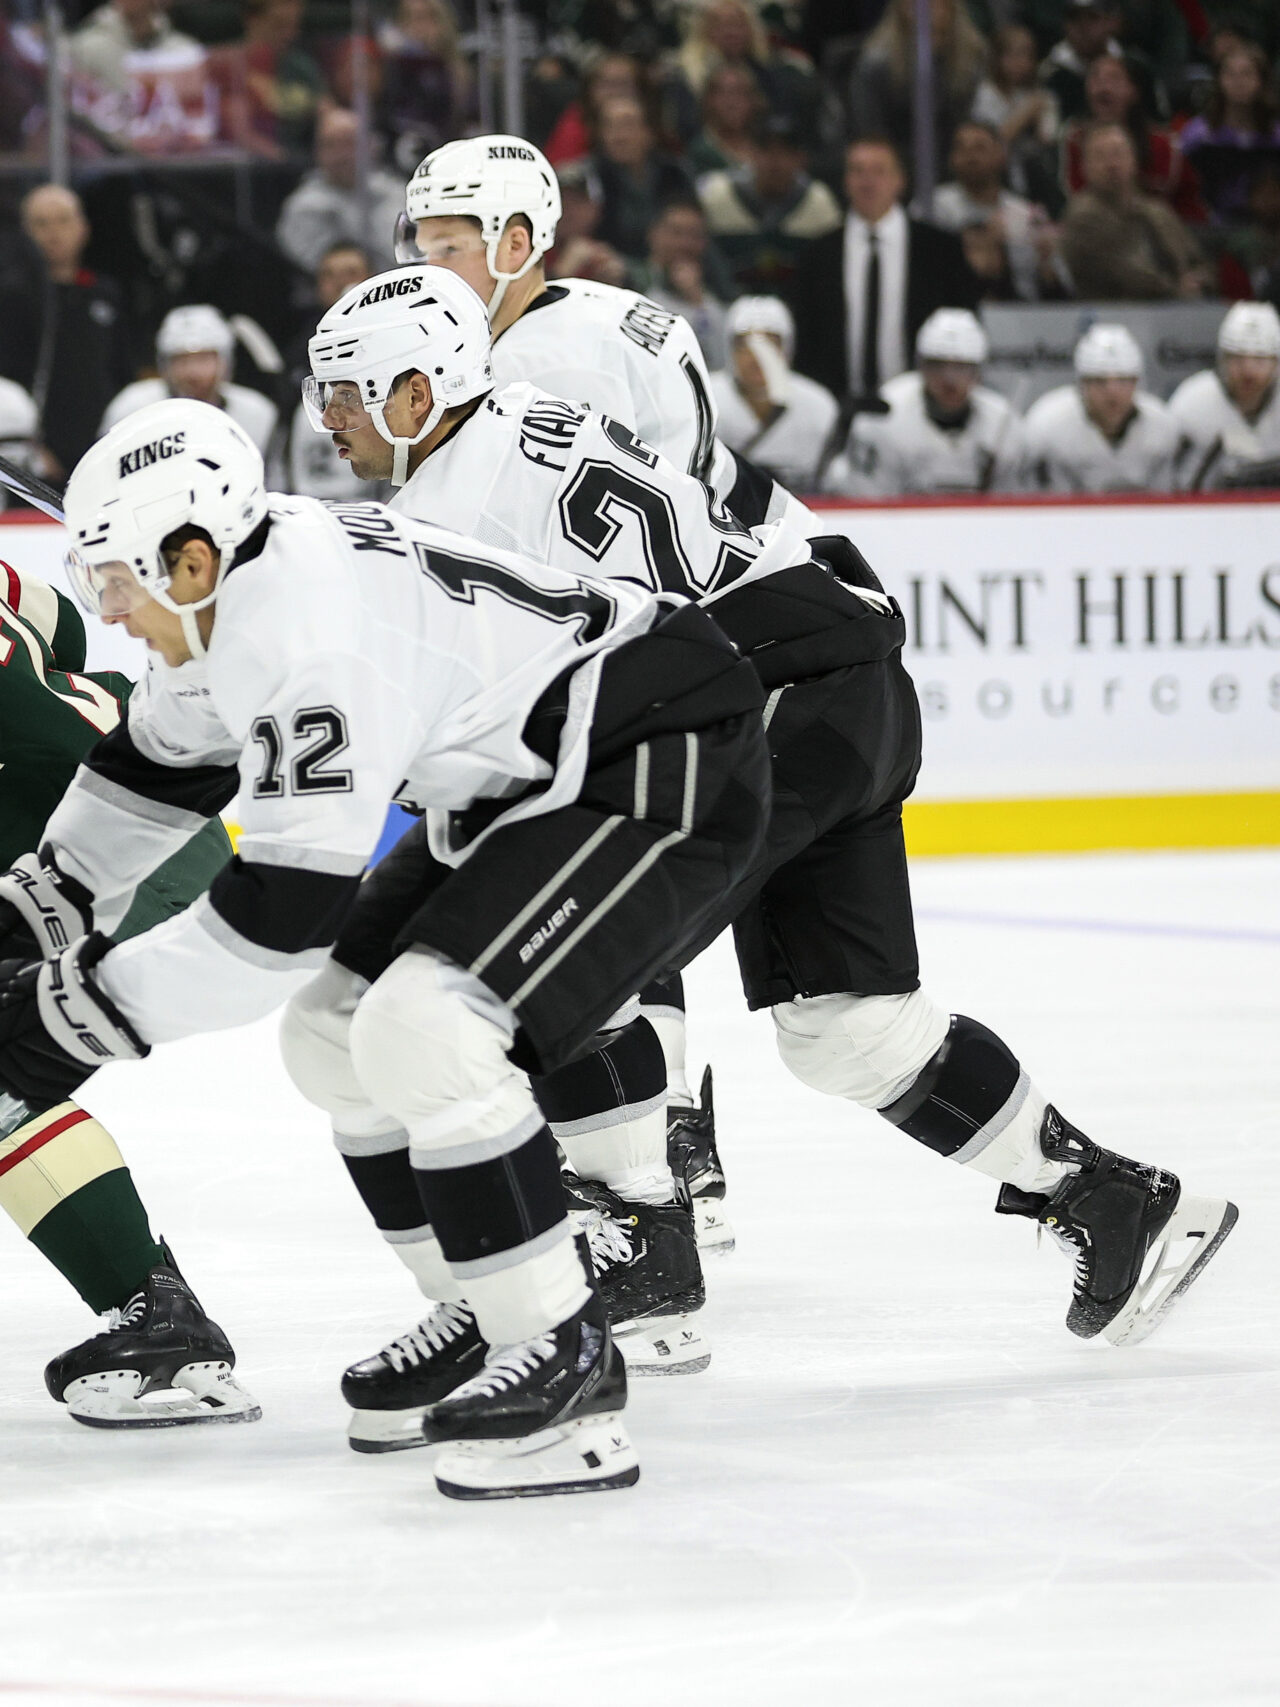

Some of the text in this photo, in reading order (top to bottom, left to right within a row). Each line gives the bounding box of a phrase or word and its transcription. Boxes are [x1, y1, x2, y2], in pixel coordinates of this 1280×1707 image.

[488, 146, 536, 161] KINGS
[358, 276, 424, 309] KINGS
[118, 431, 187, 479] KINGS
[251, 705, 353, 799] 12
[519, 897, 579, 964] BAUER
